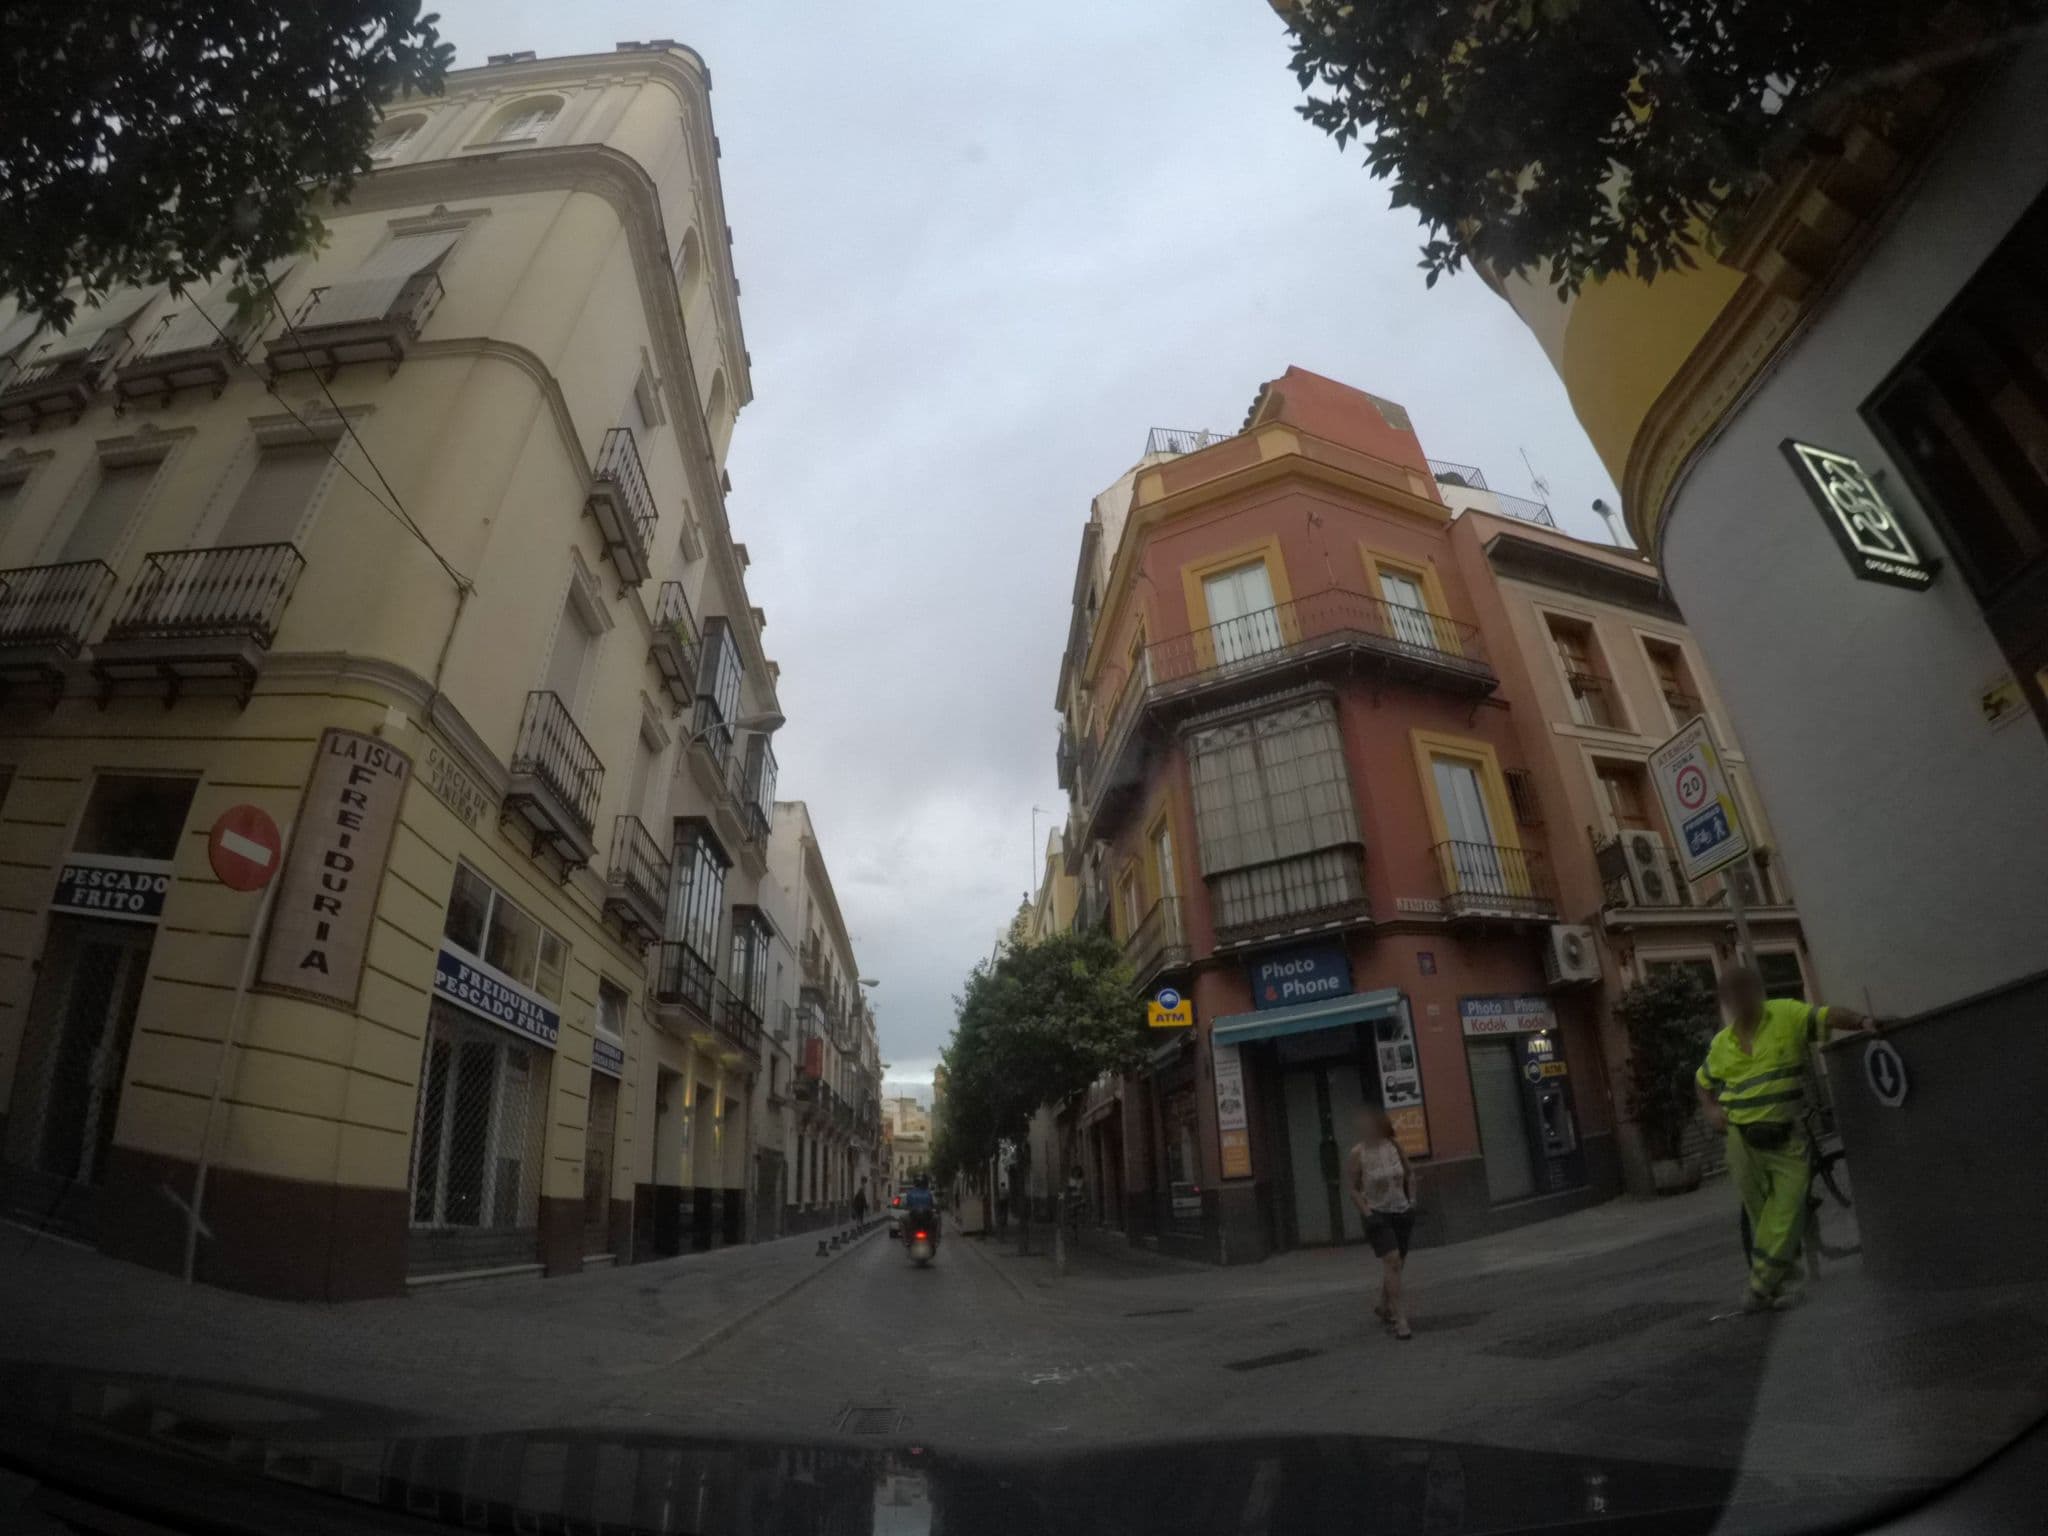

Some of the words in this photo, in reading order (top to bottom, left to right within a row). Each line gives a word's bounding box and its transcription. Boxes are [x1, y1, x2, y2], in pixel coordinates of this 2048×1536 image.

[330, 736, 358, 760] LA
[364, 744, 404, 780] ISLA
[1682, 776, 1700, 798] 20
[61, 867, 170, 894] PESCADO
[300, 763, 377, 975] FREIDURIA
[71, 887, 145, 911] FRITO
[1261, 959, 1315, 981] Photo
[458, 964, 545, 1022] FREIDURIA
[1282, 976, 1341, 999] Phone
[434, 969, 515, 1021] PESCADO
[516, 1012, 558, 1041] FRITO
[1466, 1000, 1503, 1015] Photo
[1155, 1013, 1185, 1022] ATM
[1470, 1016, 1508, 1032] Kodak
[1527, 1039, 1553, 1054] ATM
